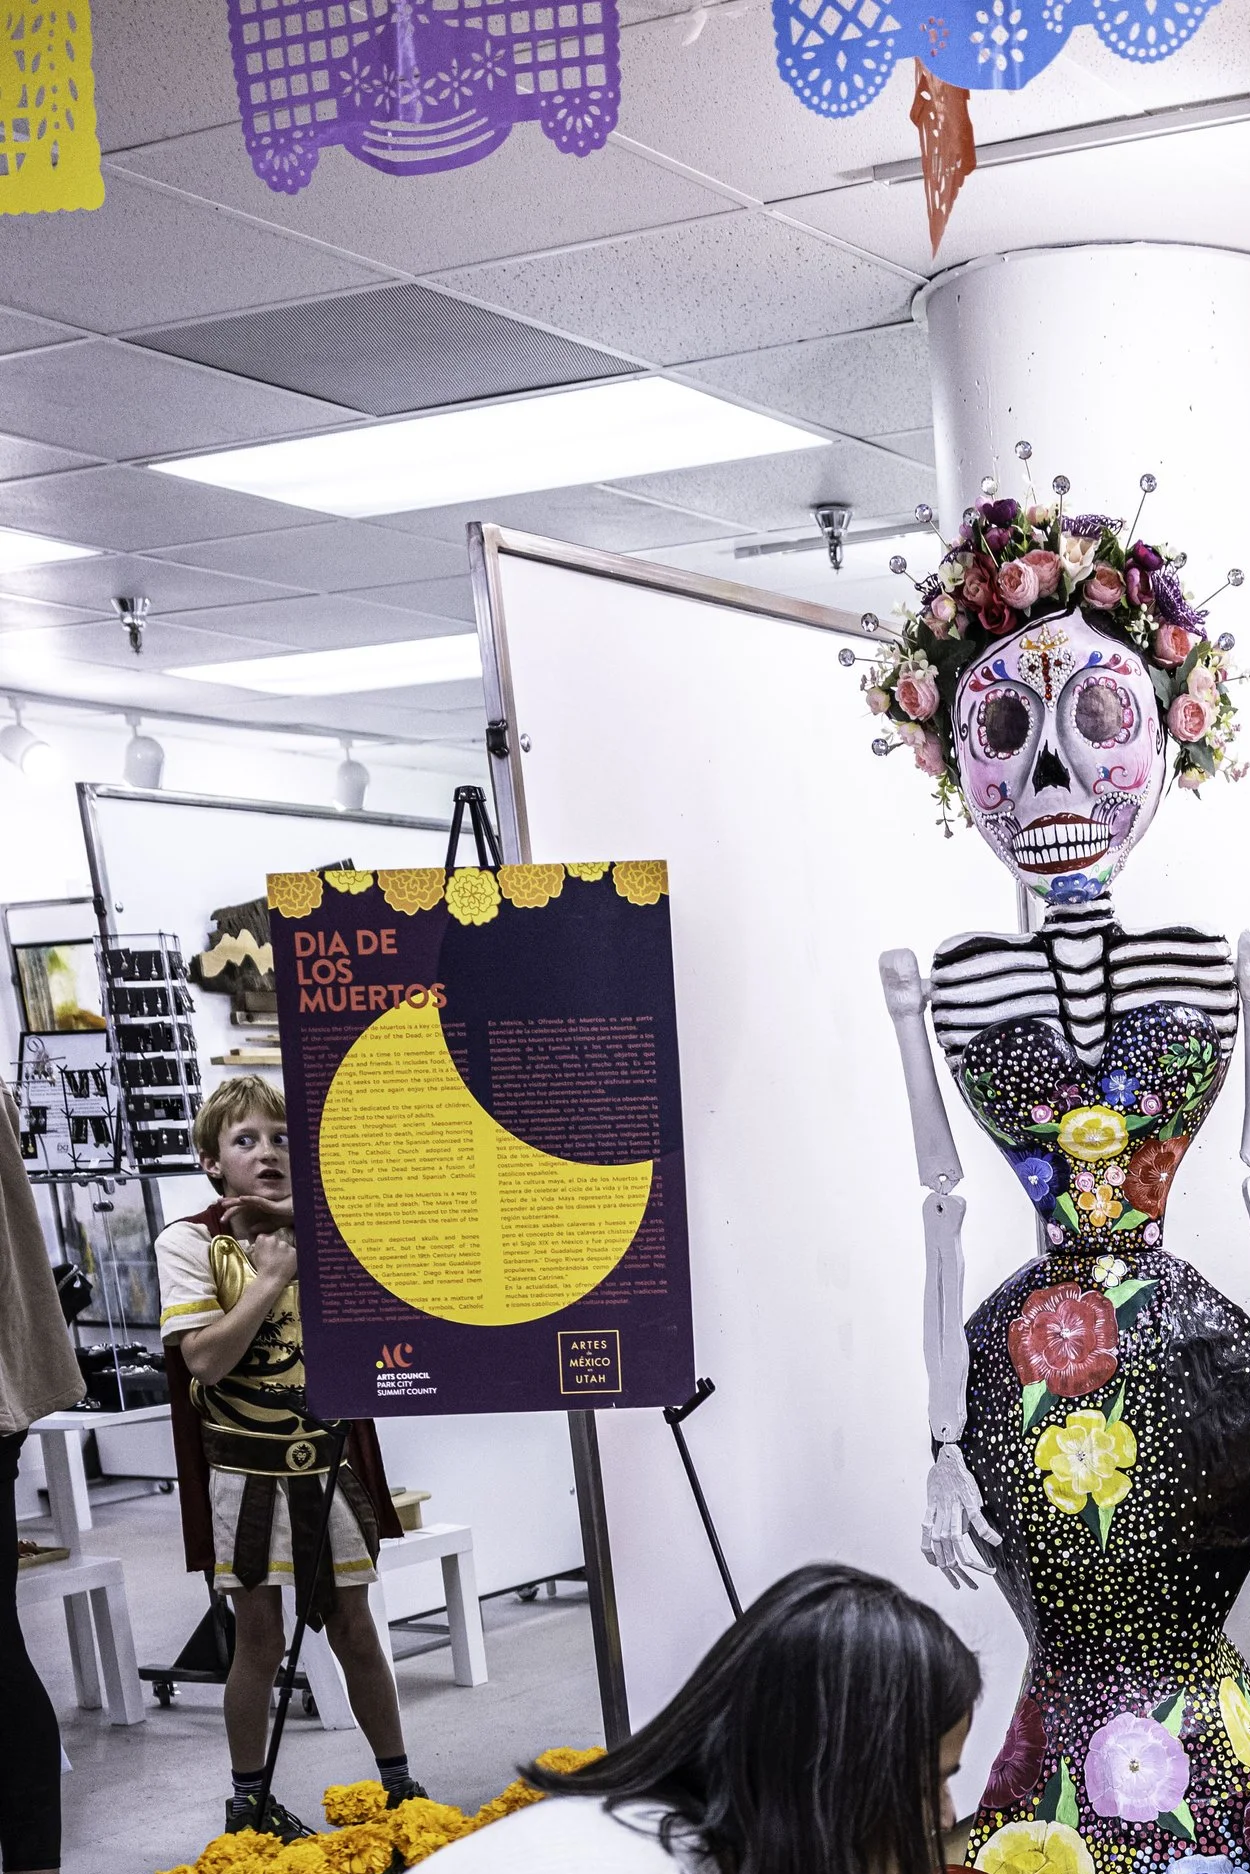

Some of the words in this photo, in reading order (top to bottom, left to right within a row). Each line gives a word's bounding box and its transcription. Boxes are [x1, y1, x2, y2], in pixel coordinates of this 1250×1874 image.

[294, 930, 349, 957] DIA
[356, 929, 398, 955] DE
[296, 958, 353, 985] LOS
[299, 983, 448, 1013] MUERTOS
[414, 1103, 434, 1111] spirits
[362, 1122, 397, 1130] throughout
[415, 1129, 444, 1138] including
[445, 1128, 473, 1137] honoring
[405, 1139, 430, 1147] Spanish
[425, 1147, 451, 1155] adopted
[339, 1176, 374, 1184] indigenous
[422, 1174, 447, 1182] Spanish
[388, 1236, 416, 1244] depicted
[379, 1253, 408, 1261] appeared
[432, 1252, 457, 1260] Century
[396, 1261, 430, 1270] printmaker
[448, 1260, 481, 1268] Guadalupe
[571, 1340, 607, 1350] ARTES
[569, 1355, 611, 1367] MÉXICO
[377, 1373, 395, 1381] ARTS
[396, 1372, 431, 1380] COUNCIL
[575, 1374, 606, 1384] UTAH
[397, 1380, 413, 1388] CITY
[377, 1388, 406, 1397] SUMMIT
[406, 1387, 438, 1395] COUNTY
